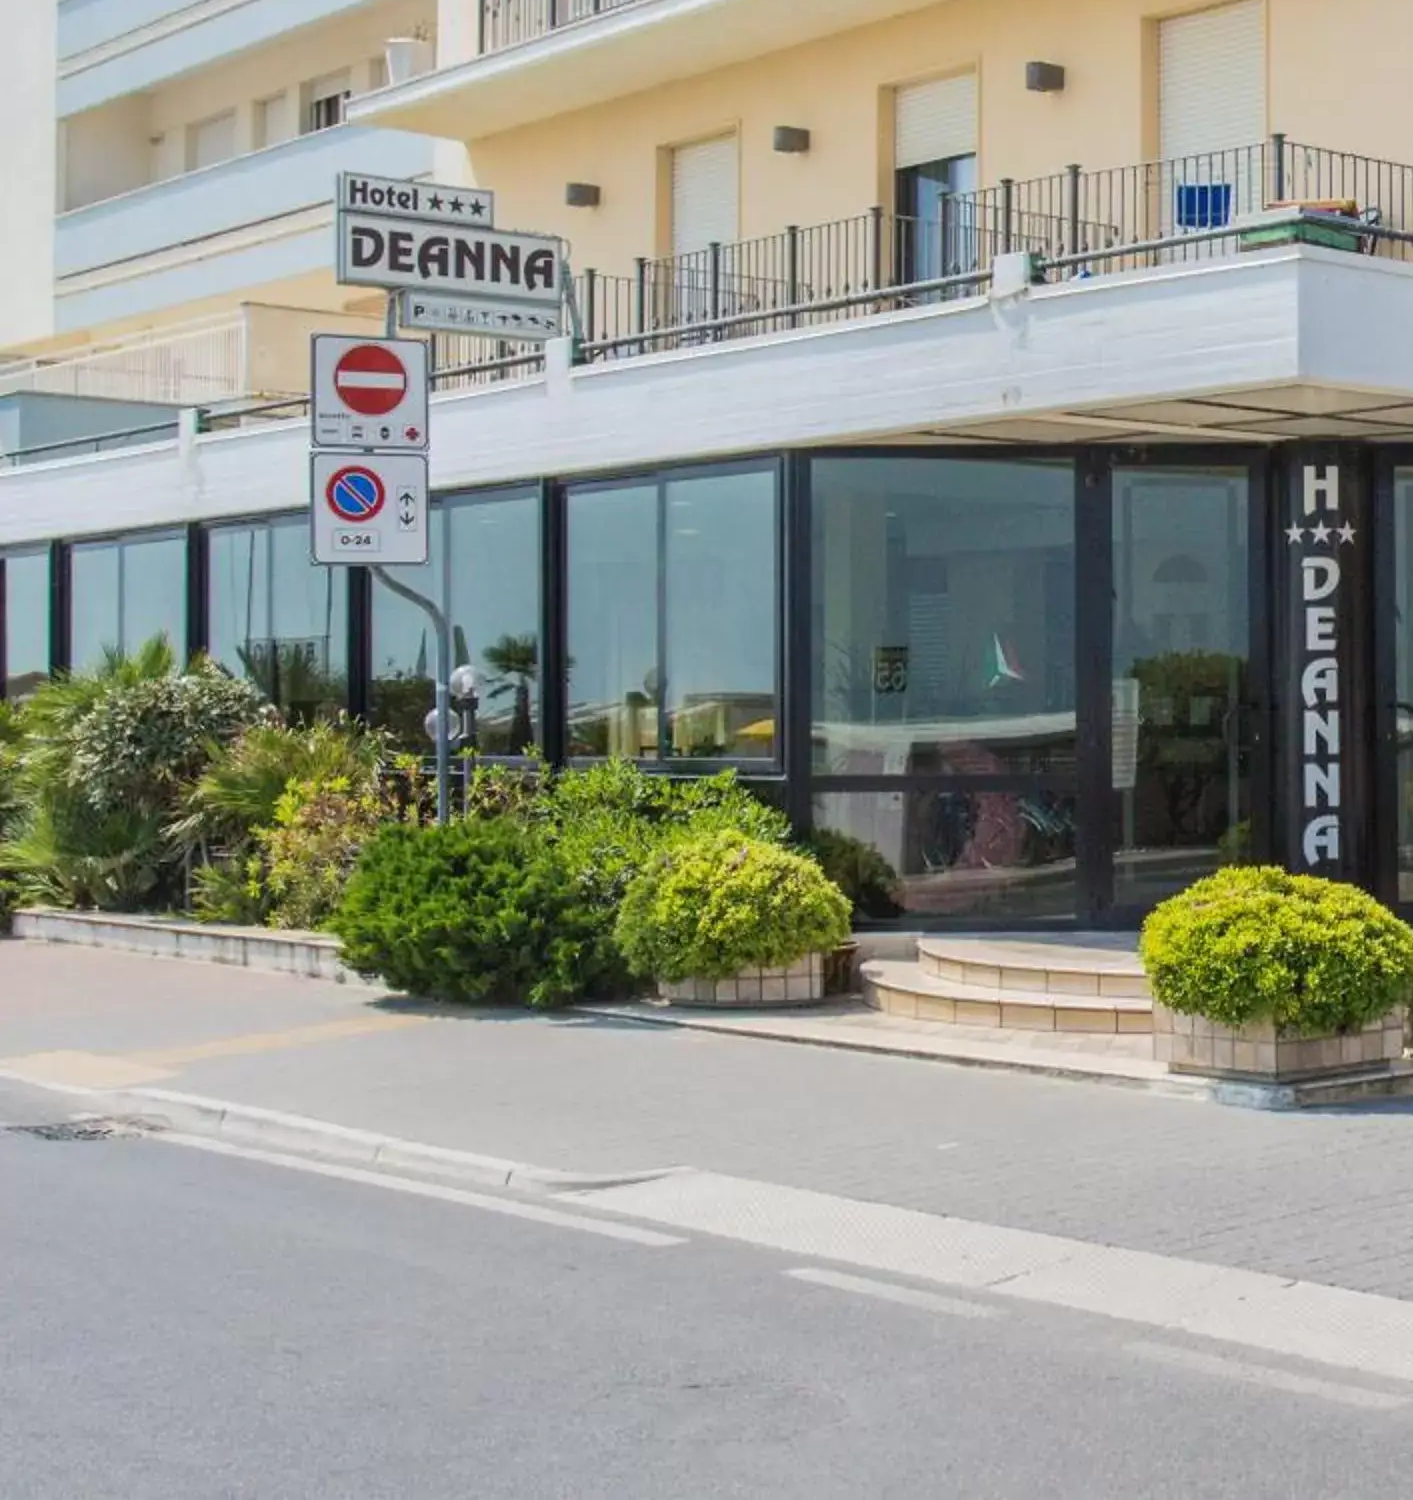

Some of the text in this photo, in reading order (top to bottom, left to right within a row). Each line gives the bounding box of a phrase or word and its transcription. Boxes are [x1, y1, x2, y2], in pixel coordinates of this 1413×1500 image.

[348, 179, 419, 211] Hotel
[351, 225, 555, 291] DEANNA
[1303, 465, 1340, 517] H
[340, 534, 372, 547] 0-24
[1300, 556, 1341, 868] DEANNA
